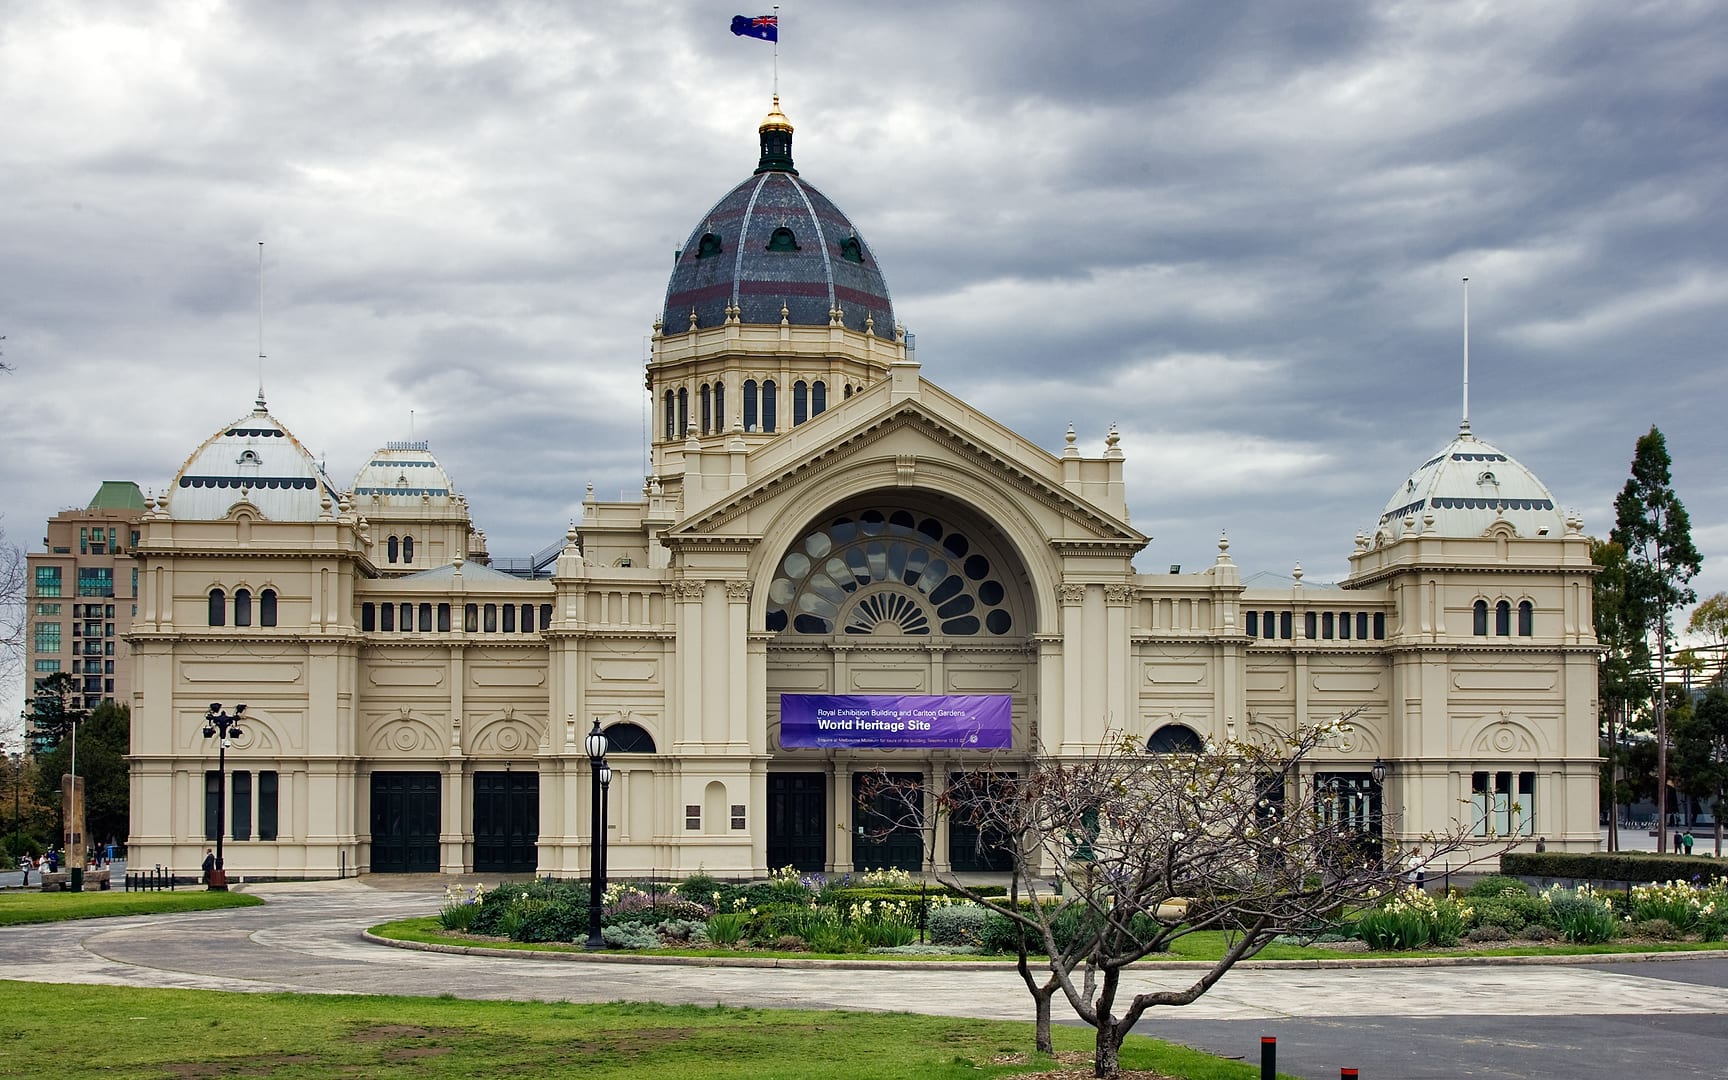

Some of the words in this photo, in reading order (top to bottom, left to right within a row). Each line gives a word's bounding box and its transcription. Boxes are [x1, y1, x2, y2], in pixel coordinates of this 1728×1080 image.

[817, 709, 836, 717] Royal
[871, 709, 898, 717] Building
[818, 720, 852, 730] World
[856, 720, 904, 732] Heritage
[908, 720, 930, 730] Site
